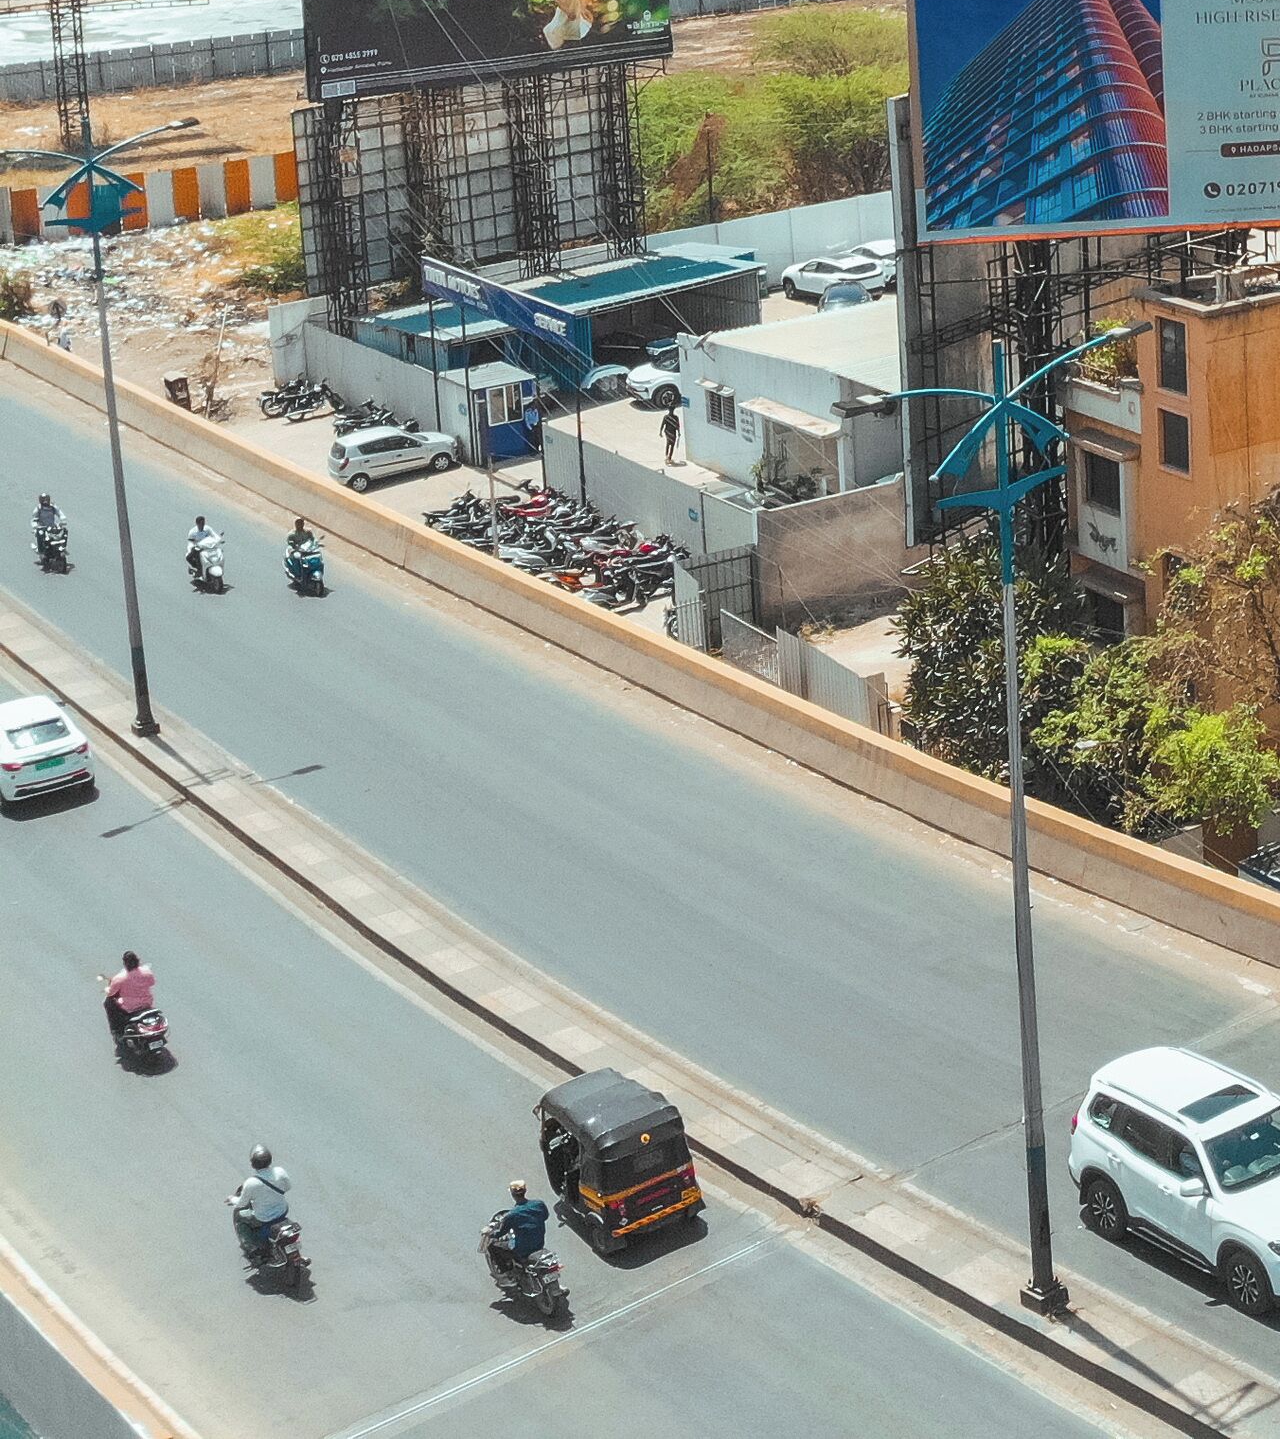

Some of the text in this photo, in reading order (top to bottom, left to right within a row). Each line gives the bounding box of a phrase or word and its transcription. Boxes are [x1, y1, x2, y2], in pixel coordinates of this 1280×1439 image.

[1196, 9, 1280, 25] HIGH-RISE
[1197, 113, 1204, 121] 2
[1206, 112, 1231, 121] BHK
[1233, 110, 1276, 121] starting
[1200, 126, 1206, 135] 3
[1208, 125, 1233, 135] BHK
[1236, 123, 1278, 134] starting
